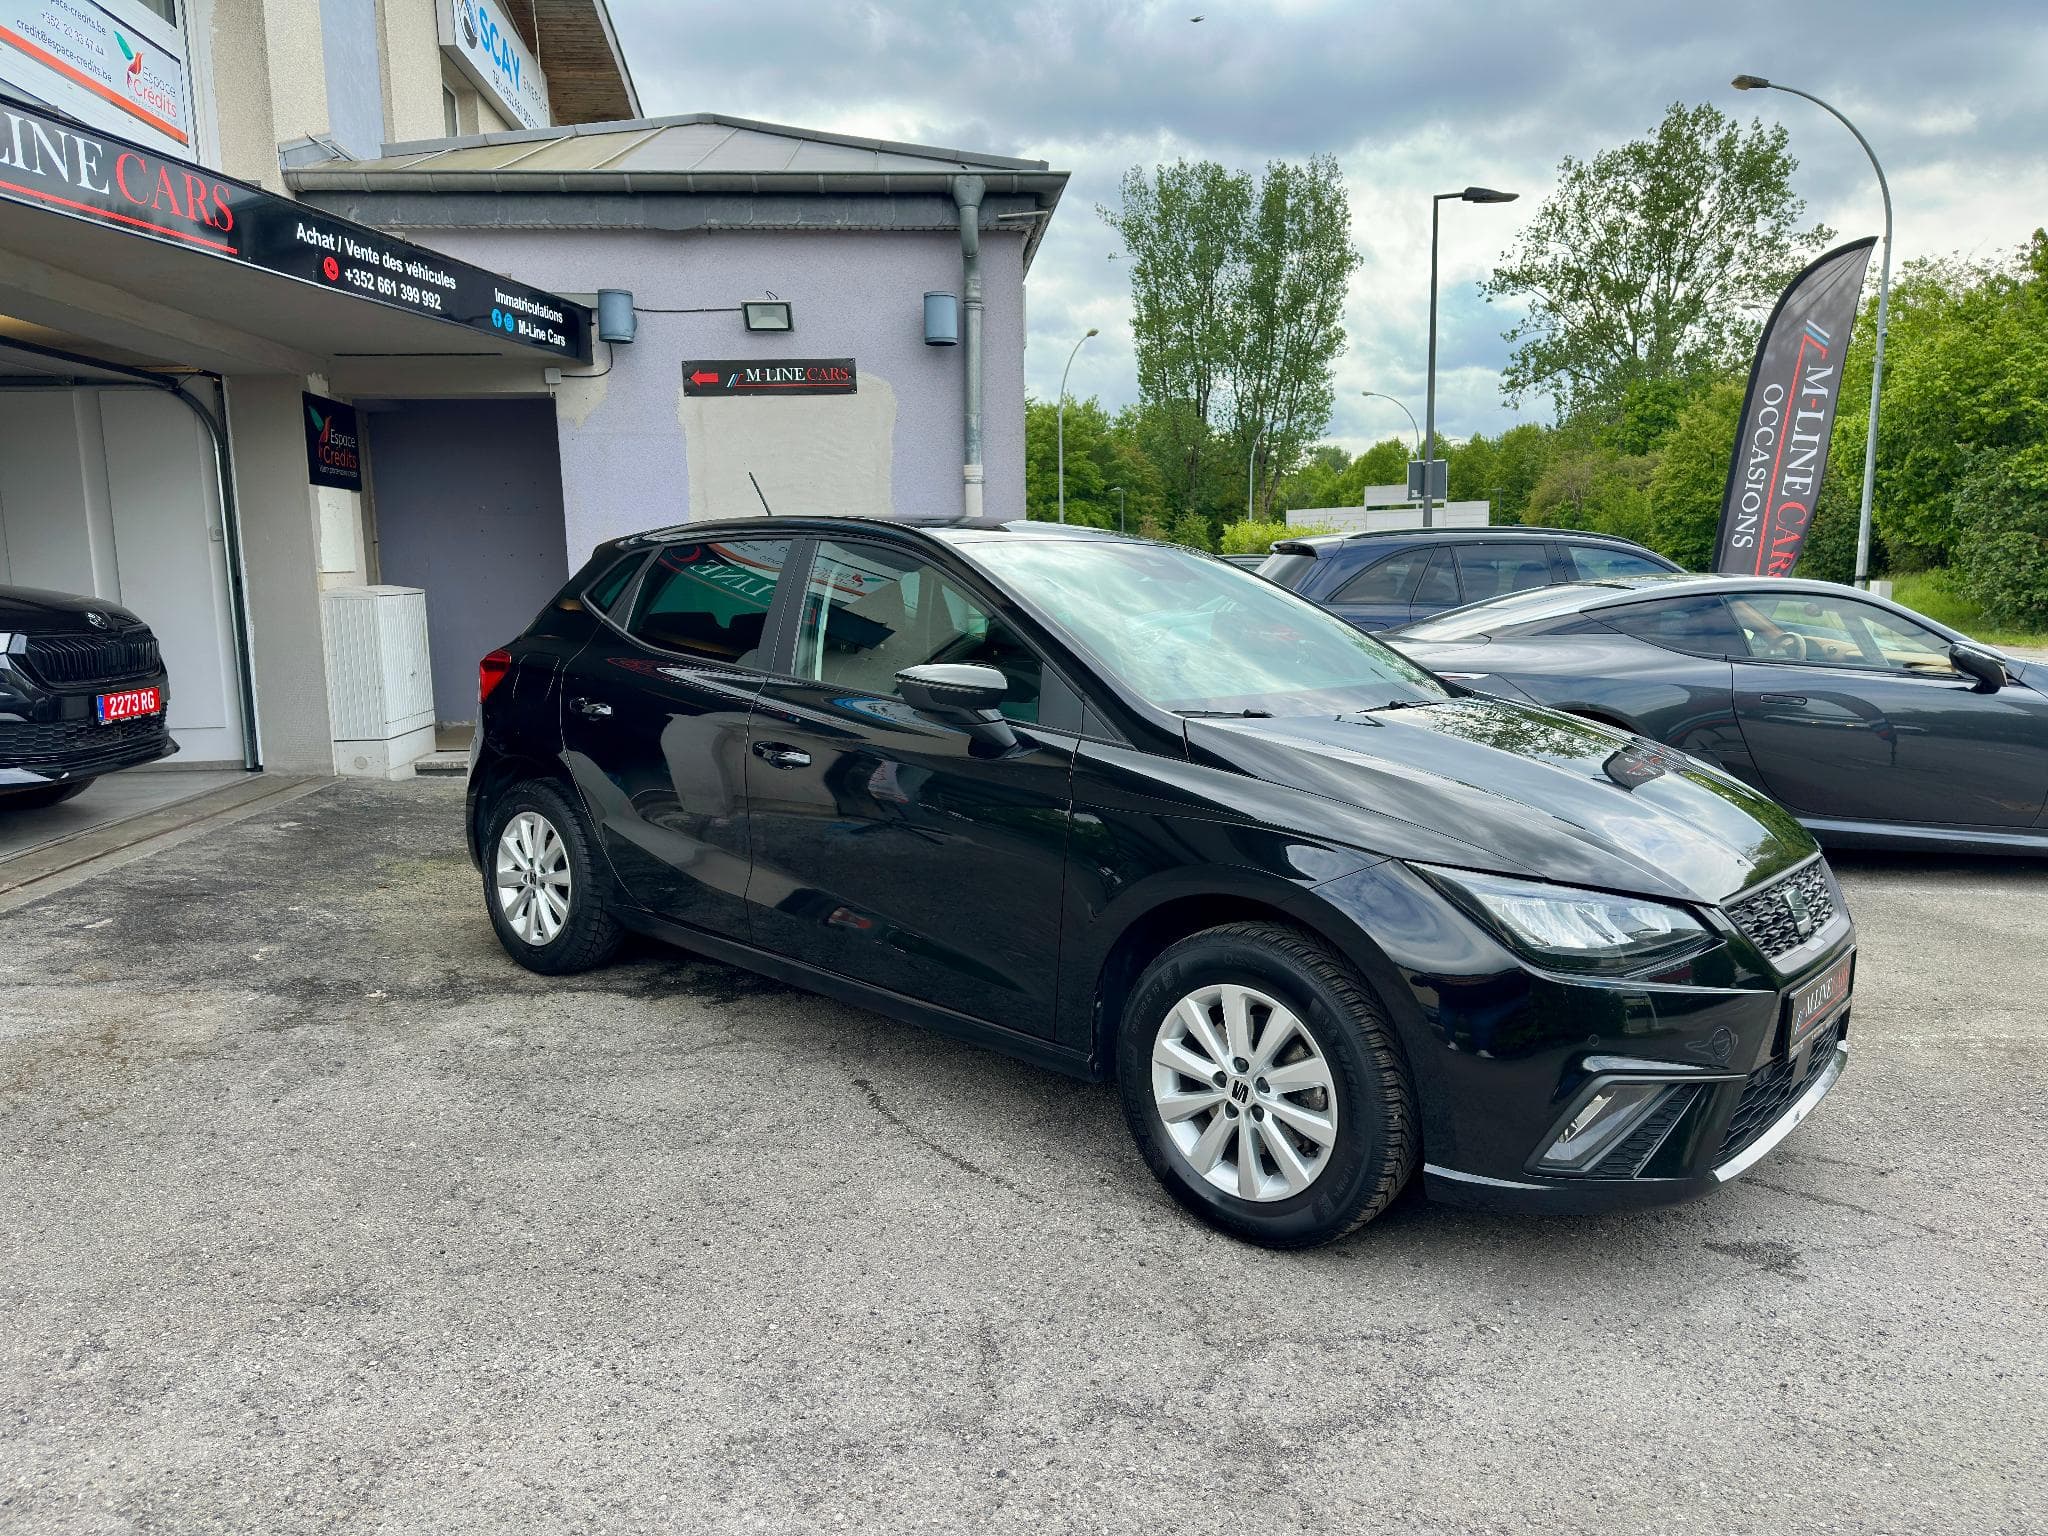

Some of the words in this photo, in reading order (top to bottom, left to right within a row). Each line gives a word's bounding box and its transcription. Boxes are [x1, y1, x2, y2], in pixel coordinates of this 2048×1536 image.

[479, 6, 520, 92] SCAY
[143, 64, 176, 97] Espace
[115, 152, 235, 232] CARS
[296, 222, 336, 252] Achat
[337, 235, 343, 253] /
[344, 236, 380, 265] Vente
[382, 252, 404, 273] des
[405, 260, 457, 290] véhicules
[345, 267, 375, 291] +352
[377, 275, 398, 297] 661
[400, 282, 420, 304] 399
[421, 289, 442, 311] 992
[494, 287, 564, 324] Immatriculations
[518, 319, 546, 343] M-Line
[547, 328, 567, 348] Cars
[745, 367, 806, 382] M-LINE
[806, 367, 849, 382] CARS
[330, 428, 356, 448] Espace
[1781, 363, 1834, 497] M-LINE
[323, 445, 357, 469] Crédits
[1732, 383, 1784, 549] OCCASIONS
[109, 693, 139, 717] 2273
[141, 690, 155, 711] RG
